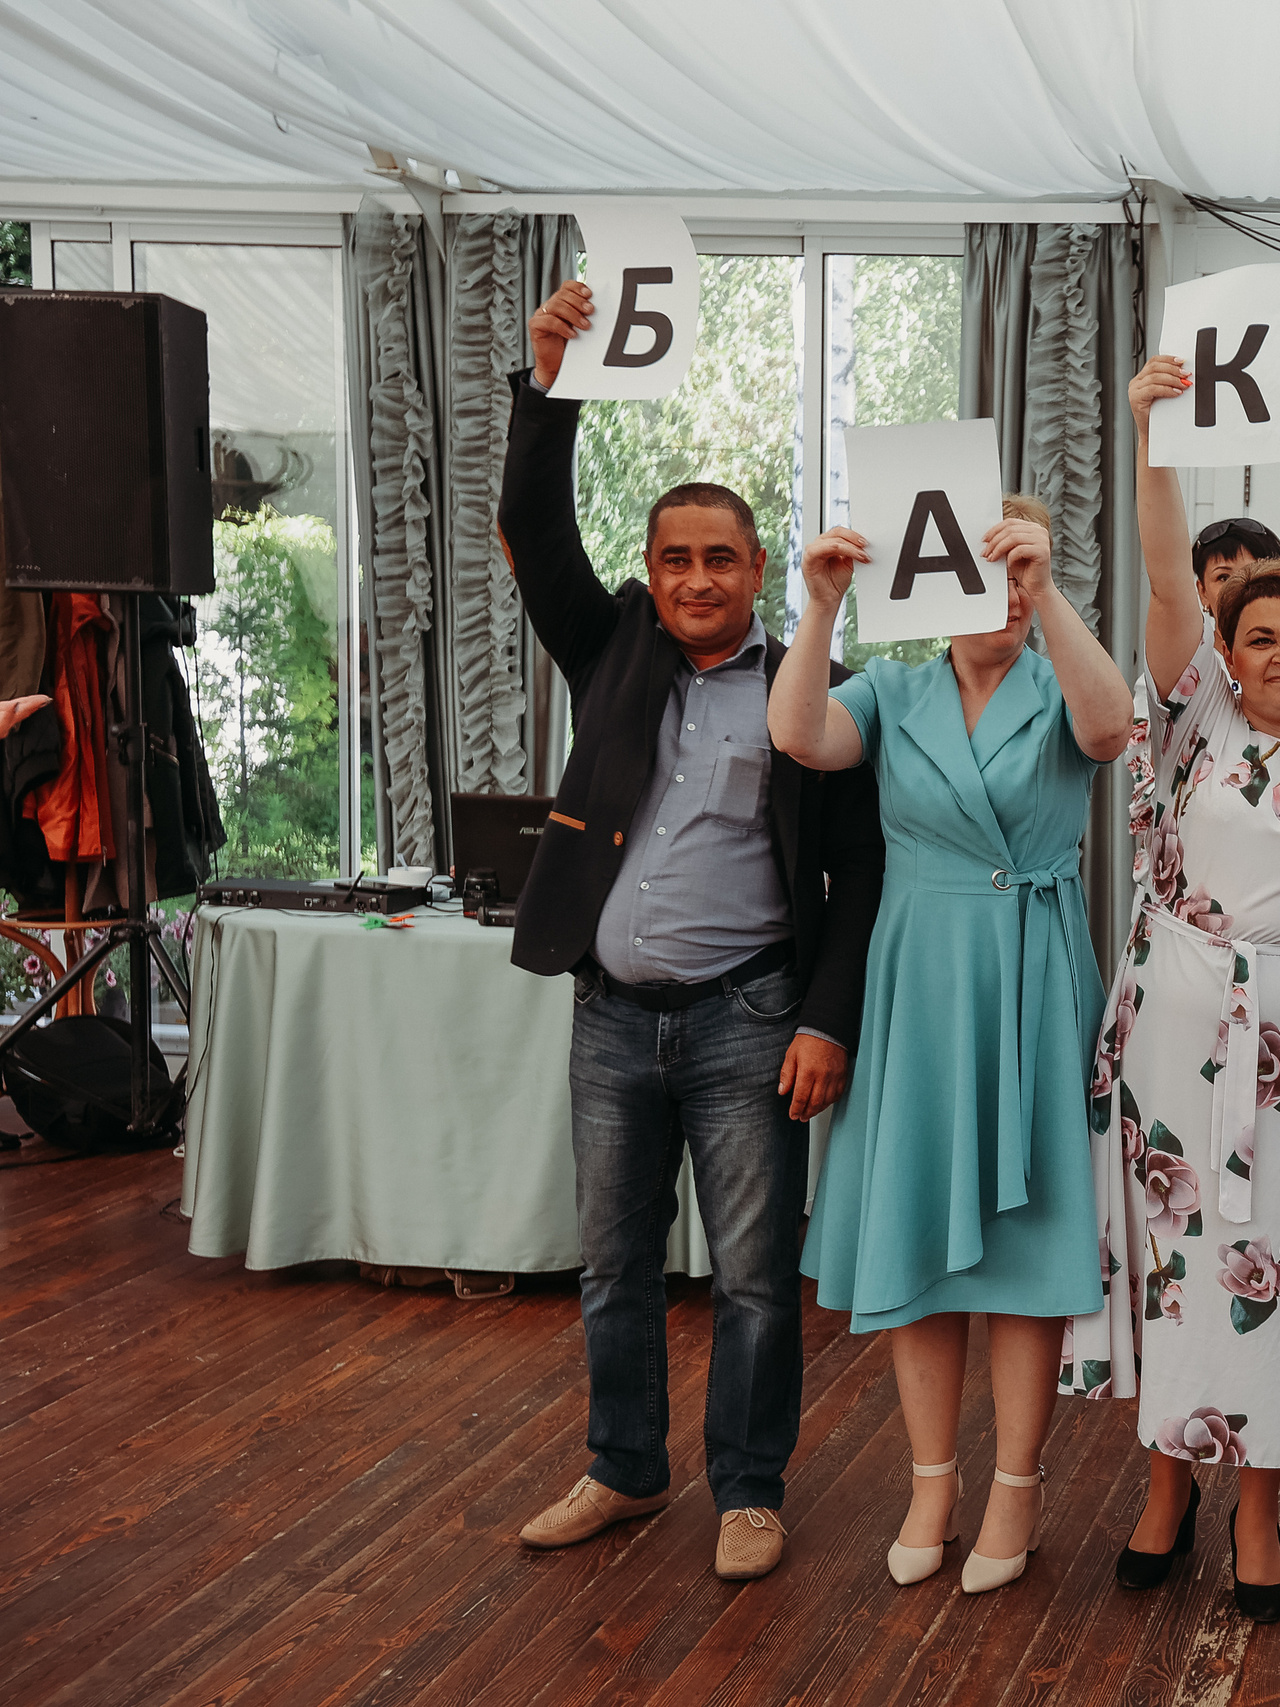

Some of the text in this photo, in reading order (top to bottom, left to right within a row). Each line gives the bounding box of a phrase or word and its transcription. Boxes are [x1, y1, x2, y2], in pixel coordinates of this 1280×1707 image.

[603, 266, 674, 368] Б
[1194, 324, 1271, 428] К
[889, 490, 987, 601] А
